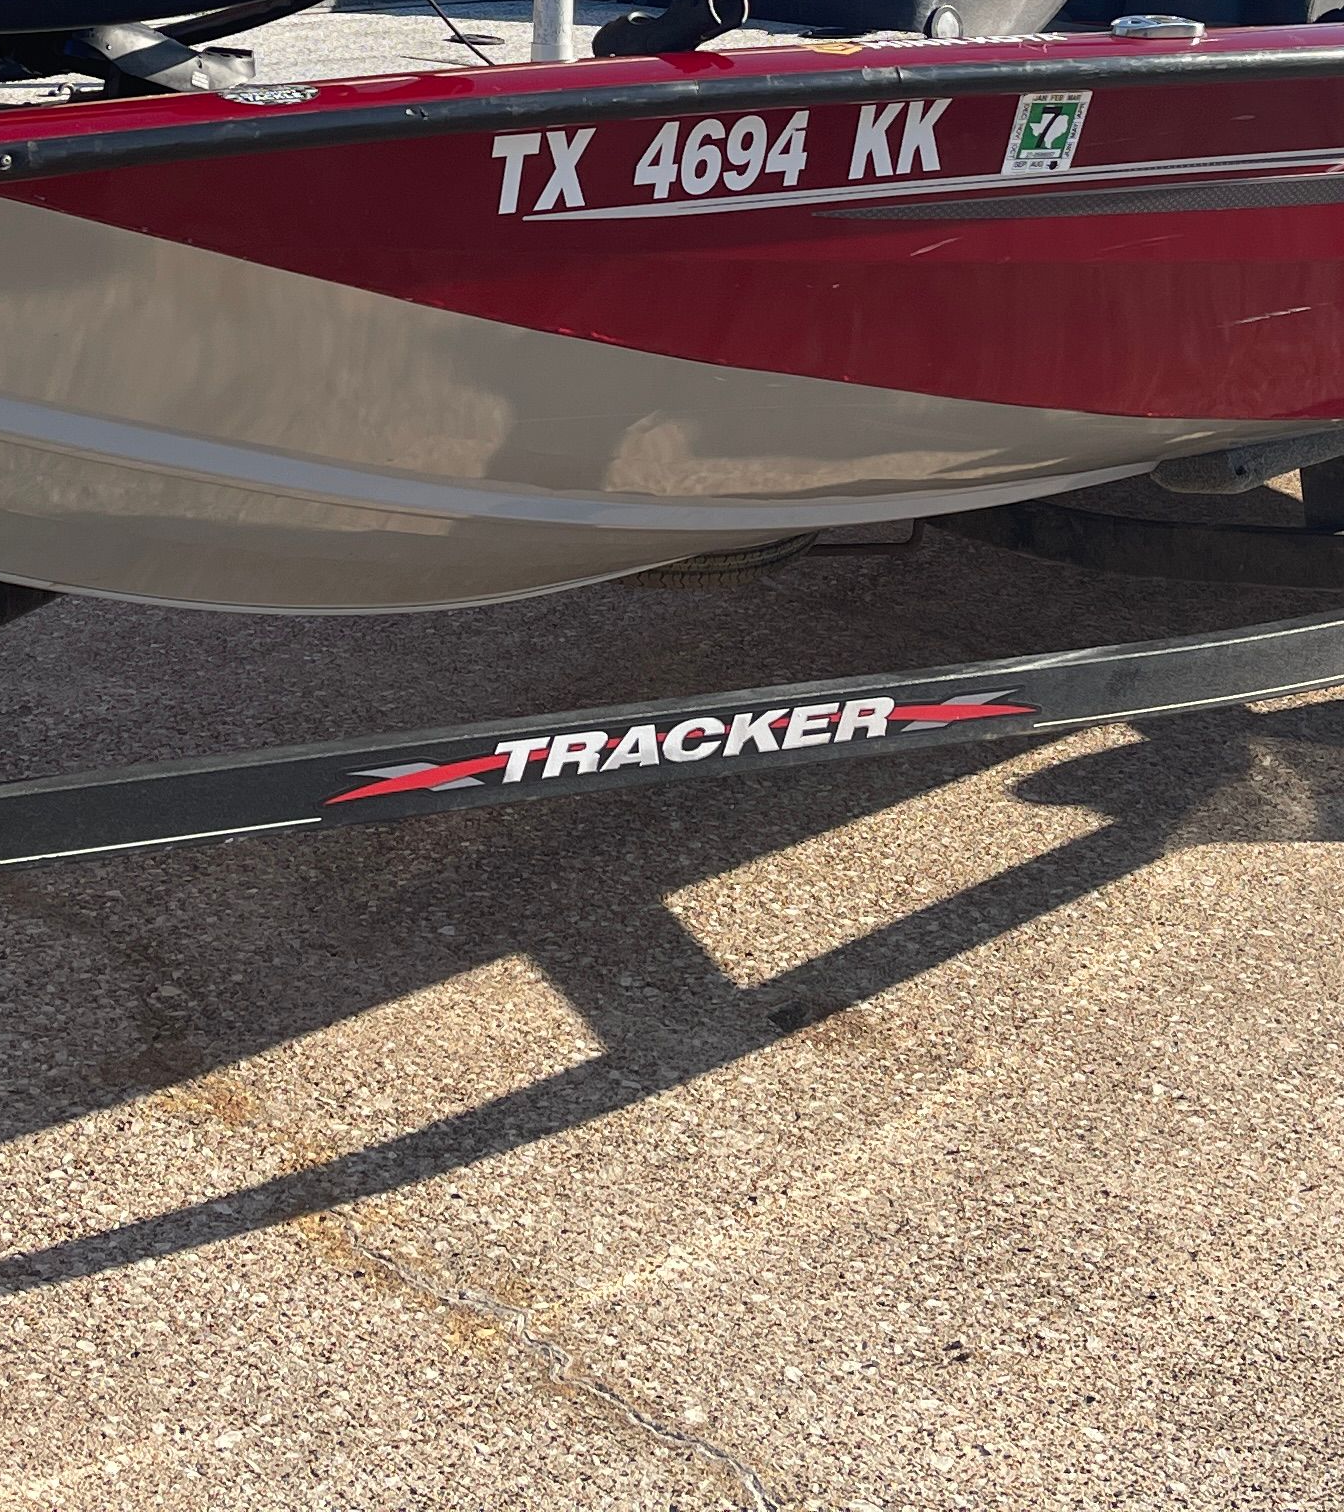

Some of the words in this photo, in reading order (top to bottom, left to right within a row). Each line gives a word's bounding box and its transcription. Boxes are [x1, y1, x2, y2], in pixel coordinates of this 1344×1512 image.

[491, 126, 596, 215] TX
[633, 110, 810, 200] 4694
[847, 97, 953, 180] KK
[493, 695, 897, 785] TRACKER
